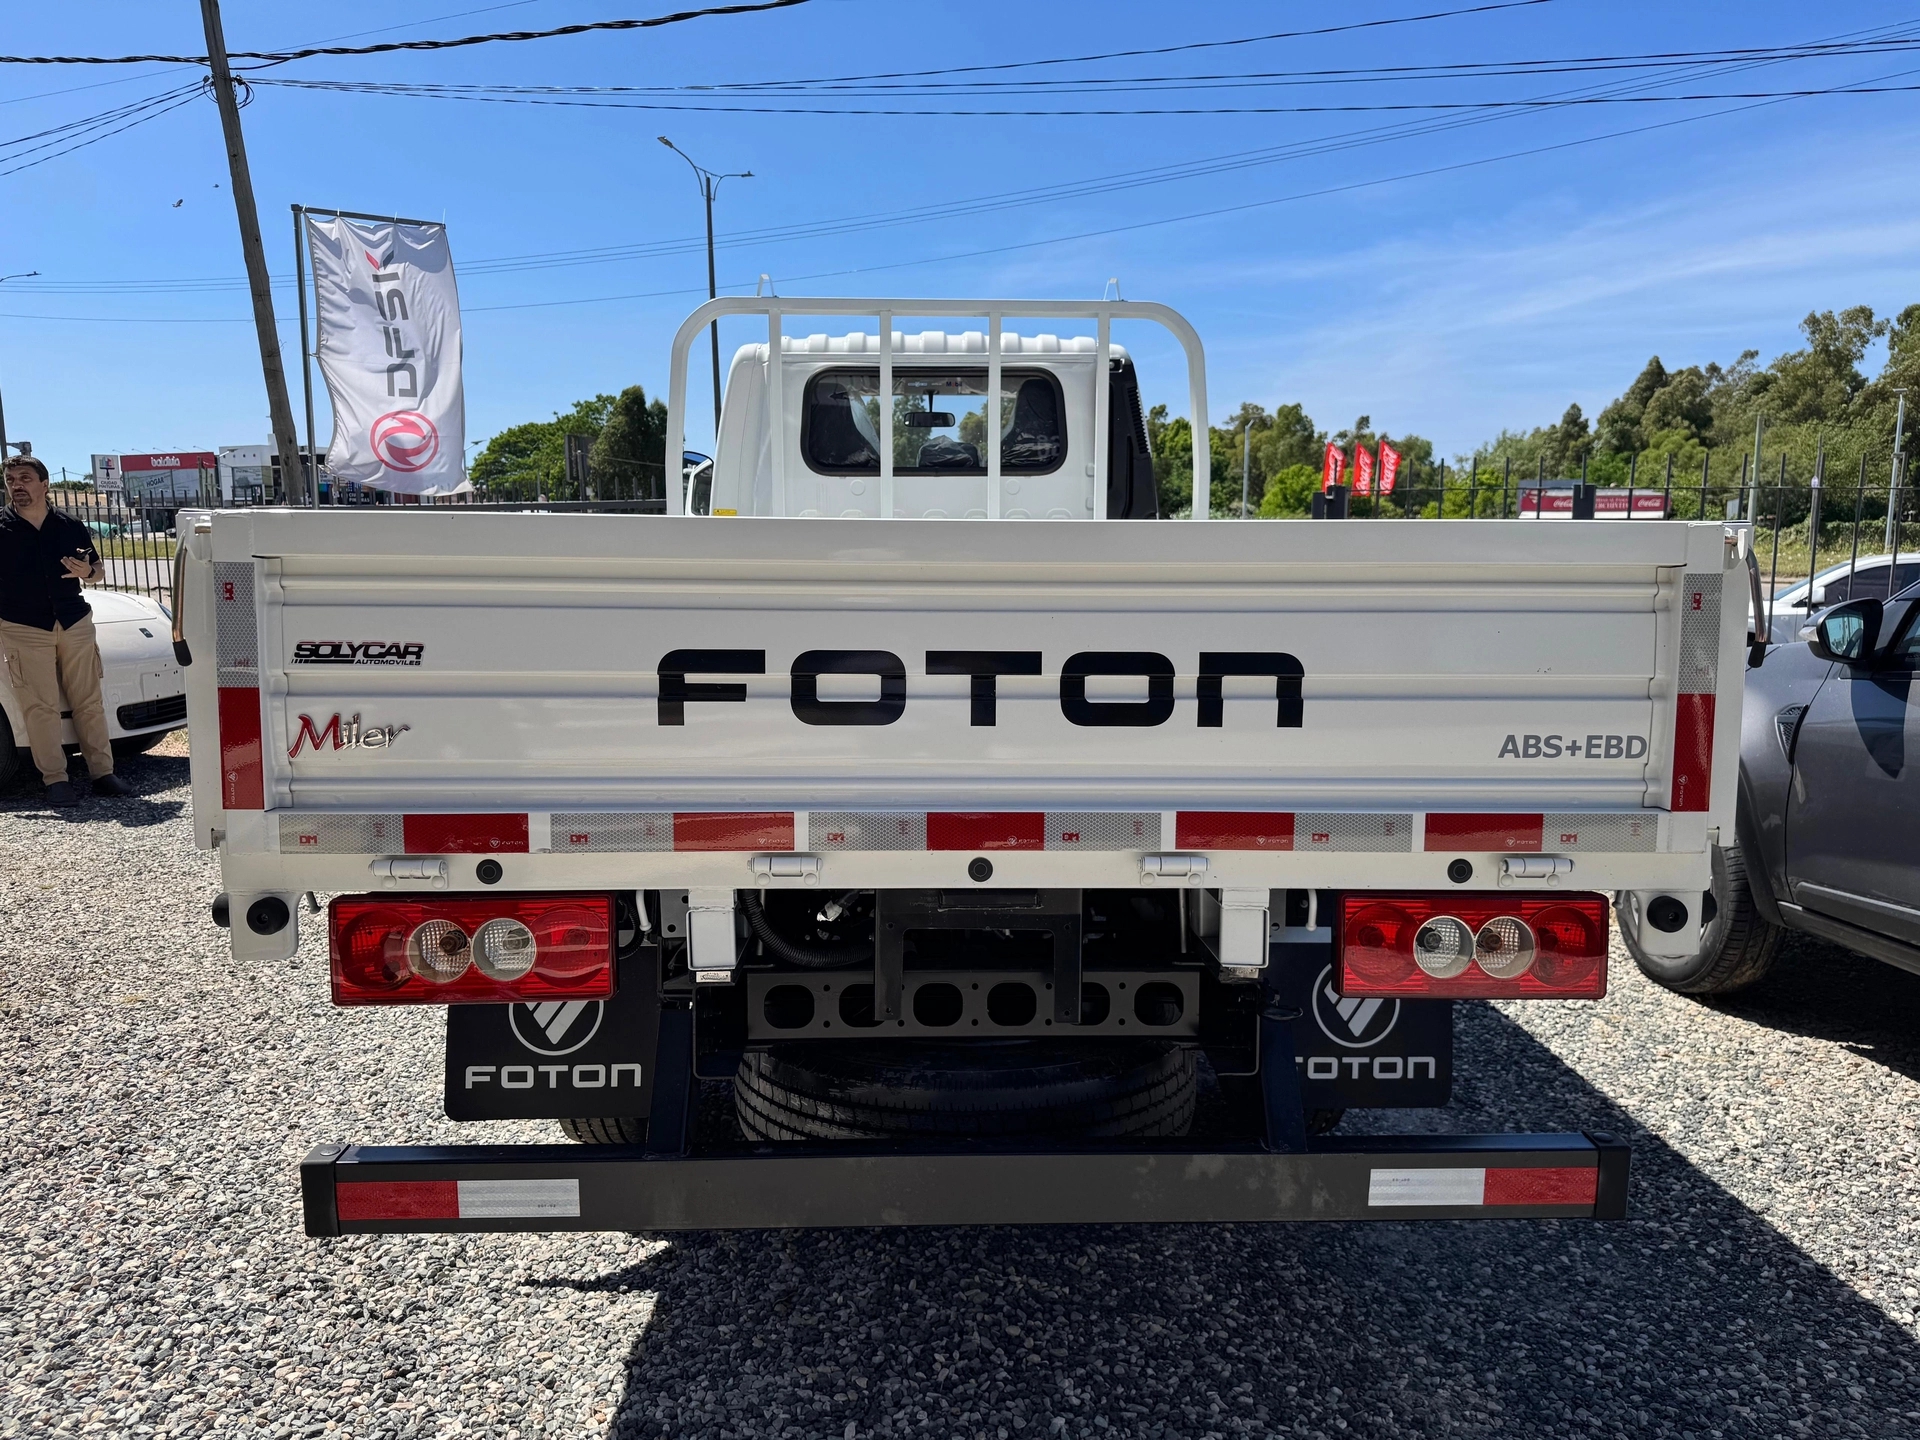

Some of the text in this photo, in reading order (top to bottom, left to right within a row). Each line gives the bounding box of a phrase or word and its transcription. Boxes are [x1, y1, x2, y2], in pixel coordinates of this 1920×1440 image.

[294, 641, 425, 659] SOLYCAR
[658, 649, 1304, 727] FOTON
[1498, 734, 1648, 759] ABS+EBD
[465, 1063, 642, 1090] FOTON
